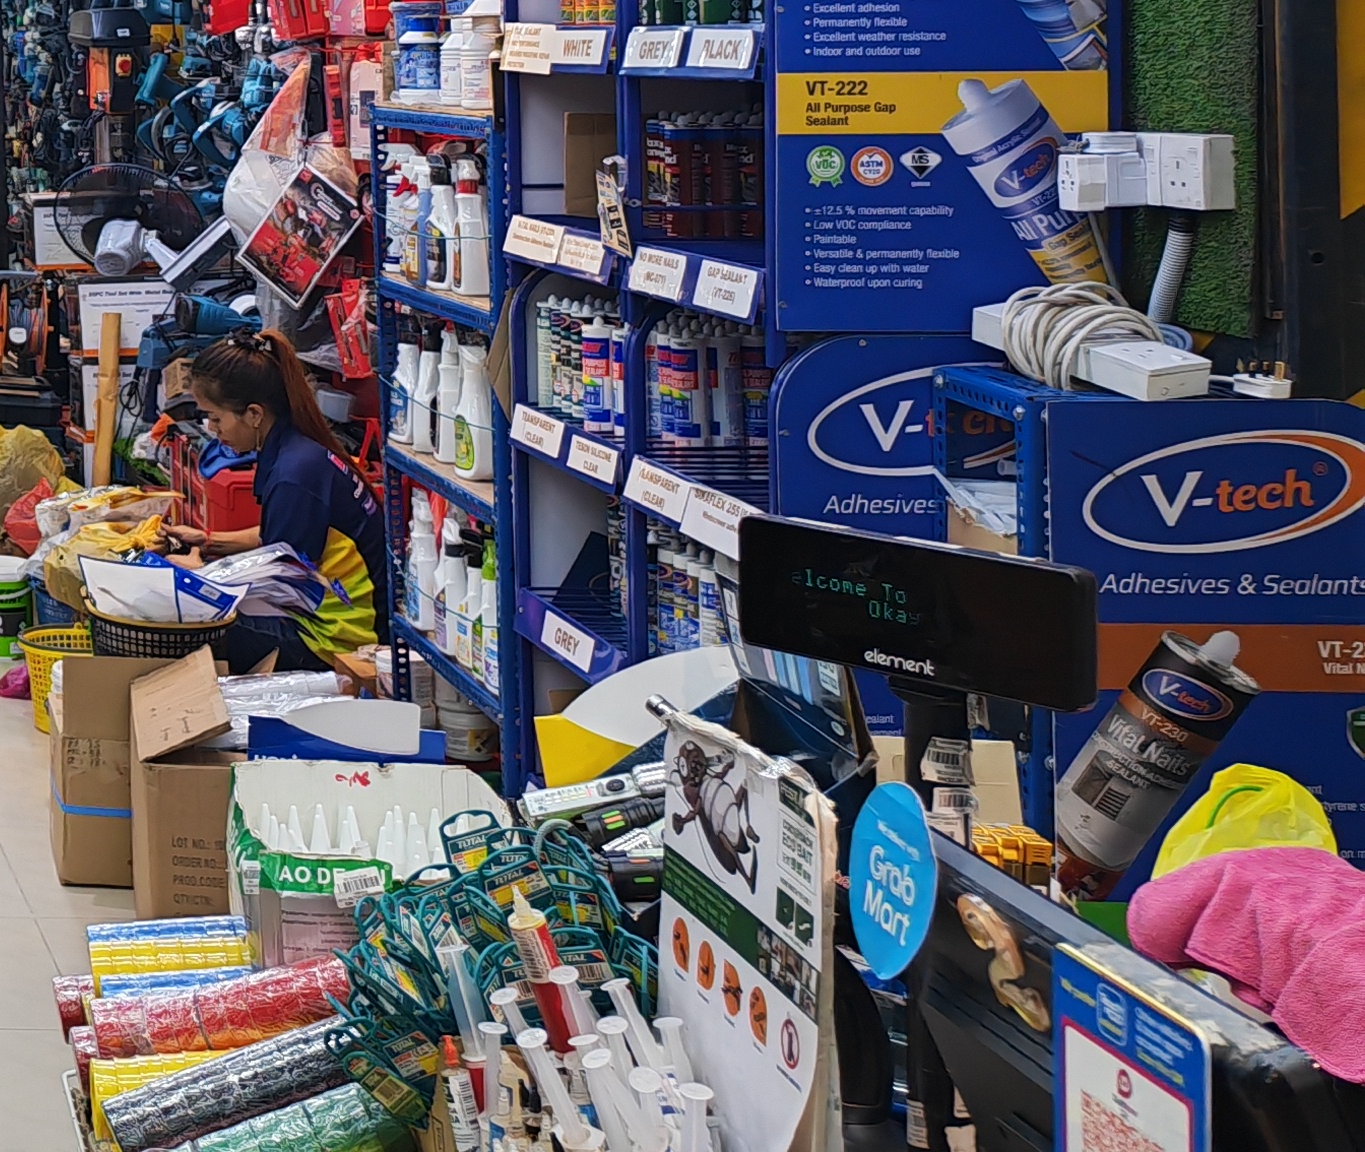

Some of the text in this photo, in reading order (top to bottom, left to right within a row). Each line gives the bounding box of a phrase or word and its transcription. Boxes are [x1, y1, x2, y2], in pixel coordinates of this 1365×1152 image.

[813, 16, 908, 29] Permanently flexible
[562, 39, 593, 57] WHITE
[639, 40, 669, 60] GREY
[703, 39, 739, 60] BLACK
[805, 80, 869, 97] VT-222
[805, 101, 897, 115] All Purpose Gap
[805, 115, 849, 126] Sealant
[813, 220, 912, 232] Low VOC compliance
[814, 263, 929, 274] Easy clean up with water
[814, 277, 923, 289] Waterproof upon curing
[522, 410, 556, 434] TRANSPARENT
[583, 460, 598, 474] CLEAR
[824, 493, 938, 514] Adhesives
[1140, 468, 1315, 527] V-tech
[881, 583, 907, 604] To
[1099, 573, 1365, 596] Adhesives & Sealants
[554, 625, 580, 656] GREY
[864, 648, 935, 676] element
[1323, 662, 1354, 674] Vital
[1159, 675, 1212, 714] V-tech
[1140, 708, 1190, 743] VT-230
[1107, 714, 1192, 777] Vital Nails
[1107, 759, 1151, 790] SEALANT
[456, 835, 486, 848] TOTAL
[172, 856, 201, 868] ORDER
[279, 865, 310, 883] AO
[495, 869, 524, 886] TOTAL
[870, 845, 915, 906] Grab
[863, 879, 910, 946] Mart
